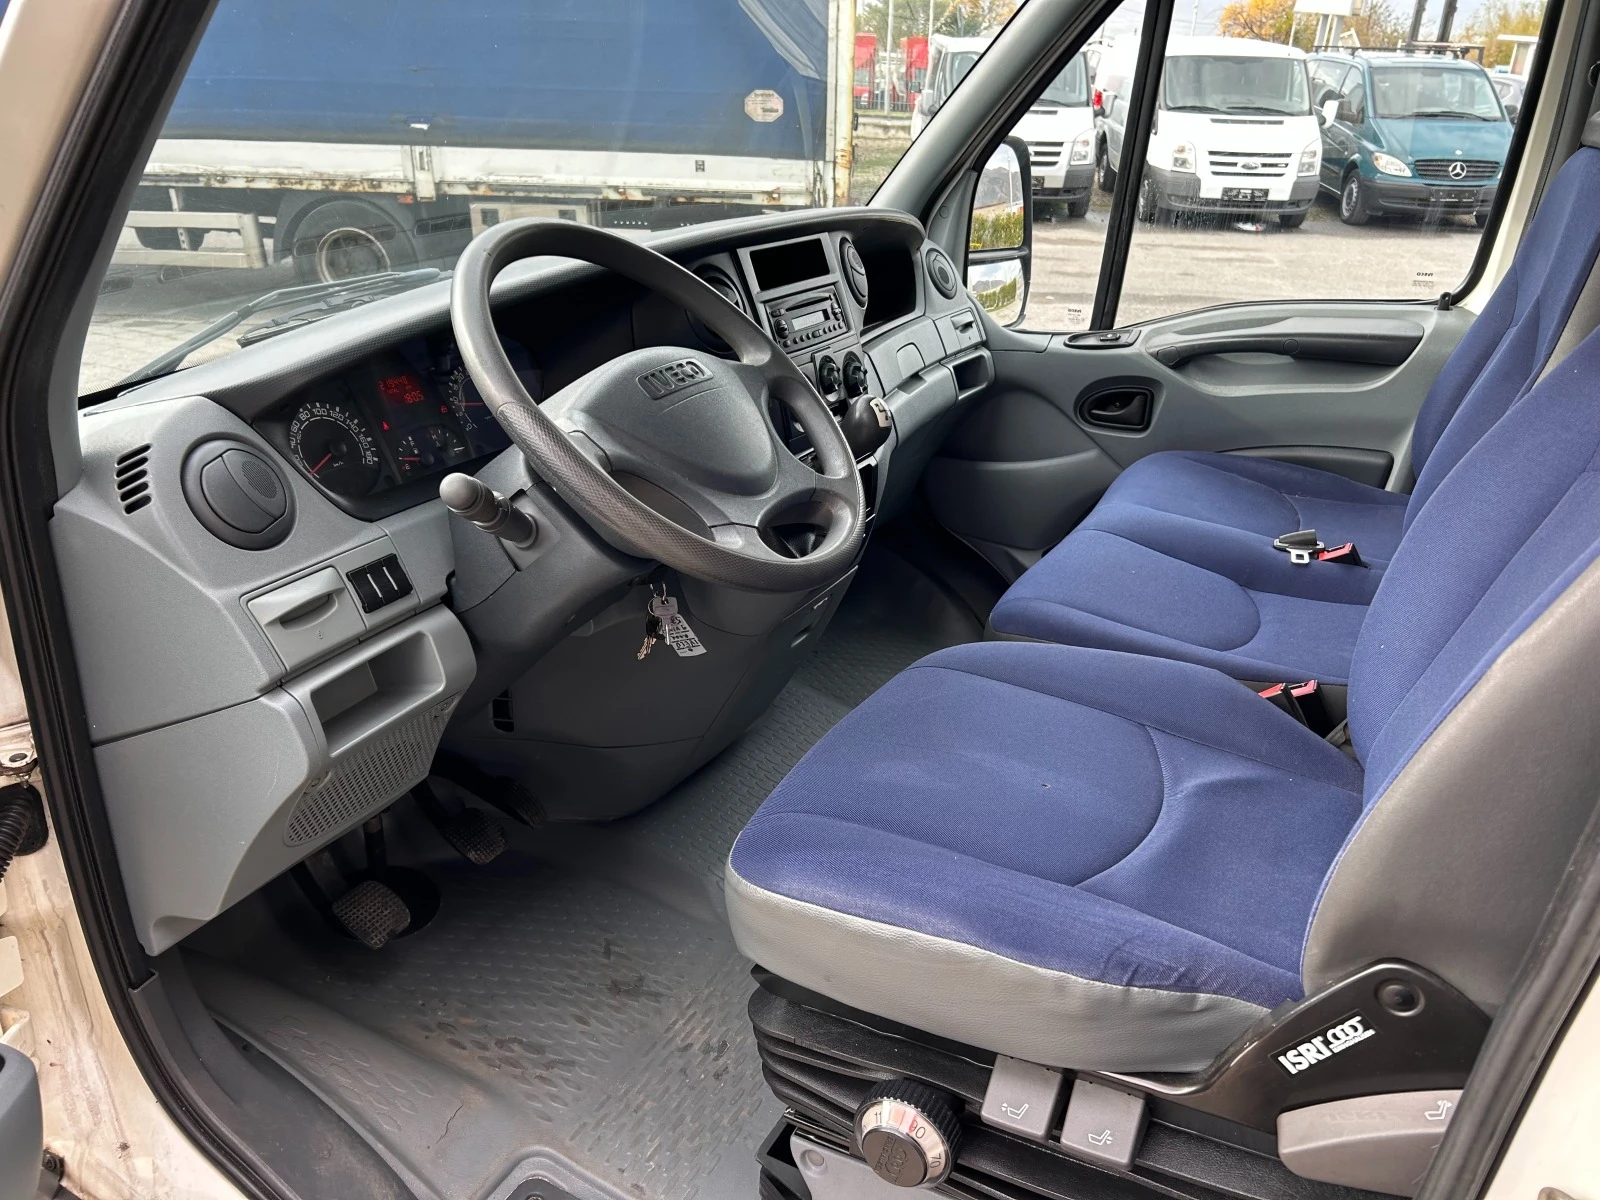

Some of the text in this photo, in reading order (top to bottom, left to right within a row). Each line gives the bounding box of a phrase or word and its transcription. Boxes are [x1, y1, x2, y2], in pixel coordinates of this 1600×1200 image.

[643, 360, 706, 394] IVECO
[299, 410, 311, 421] 80
[312, 408, 328, 416] 100
[329, 410, 345, 421] 120
[290, 420, 300, 433] 60
[345, 419, 360, 433] 140
[358, 433, 370, 449] 160
[365, 450, 374, 465] 180
[1277, 1035, 1333, 1075] ISRI
[929, 1152, 942, 1170] 70
